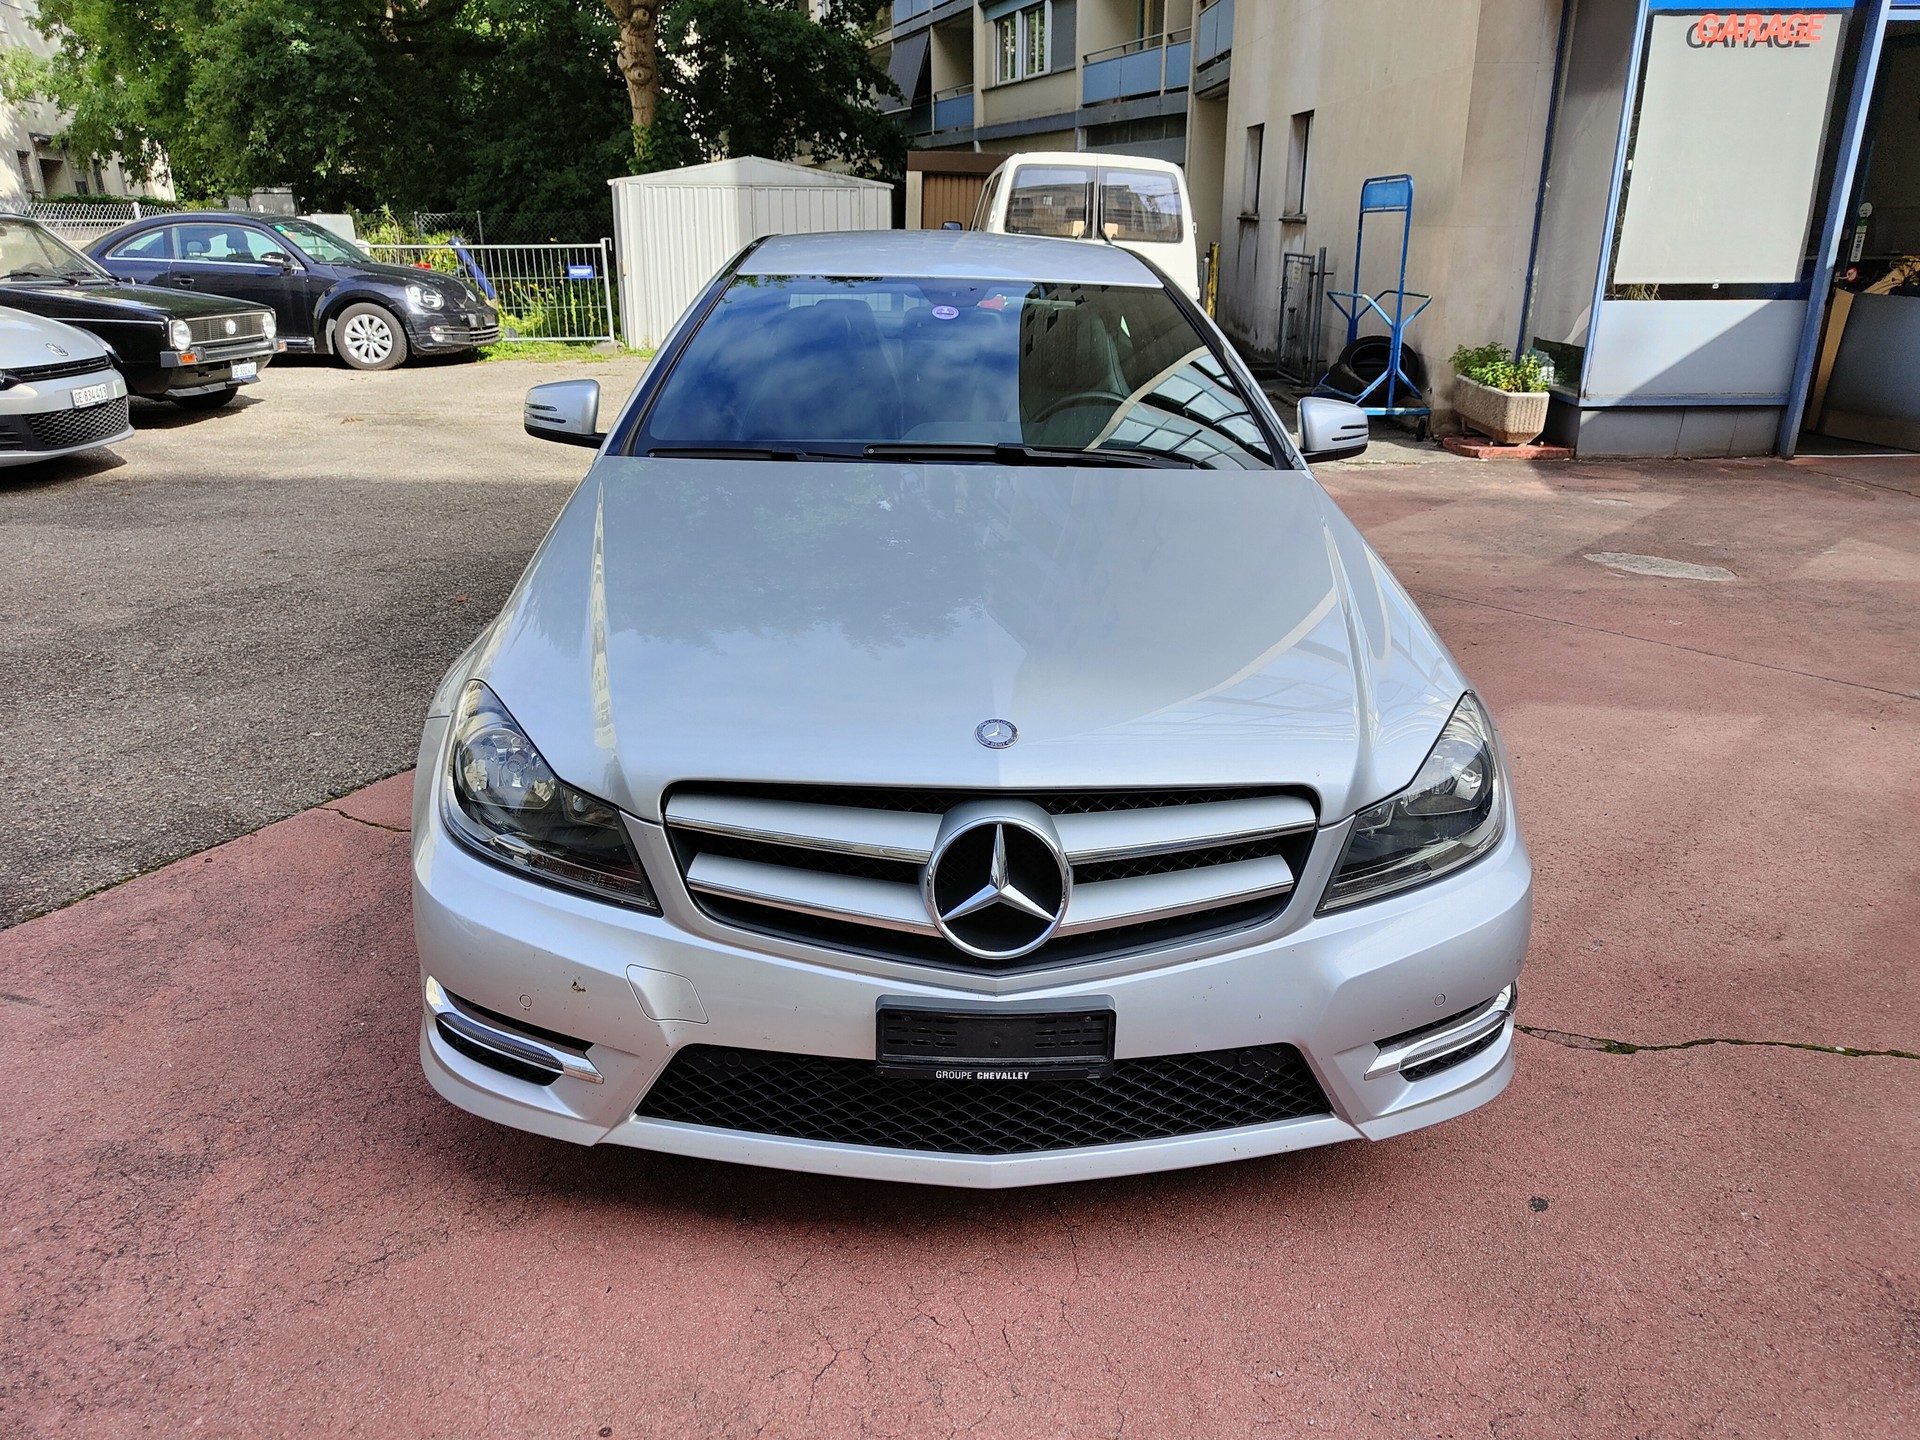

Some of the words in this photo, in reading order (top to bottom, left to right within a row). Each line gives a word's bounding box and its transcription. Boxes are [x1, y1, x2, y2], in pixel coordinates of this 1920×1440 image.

[1697, 12, 1825, 42] GARAGE
[935, 1070, 973, 1080] GROUPE
[976, 1071, 1030, 1080] CHEVALLEY
